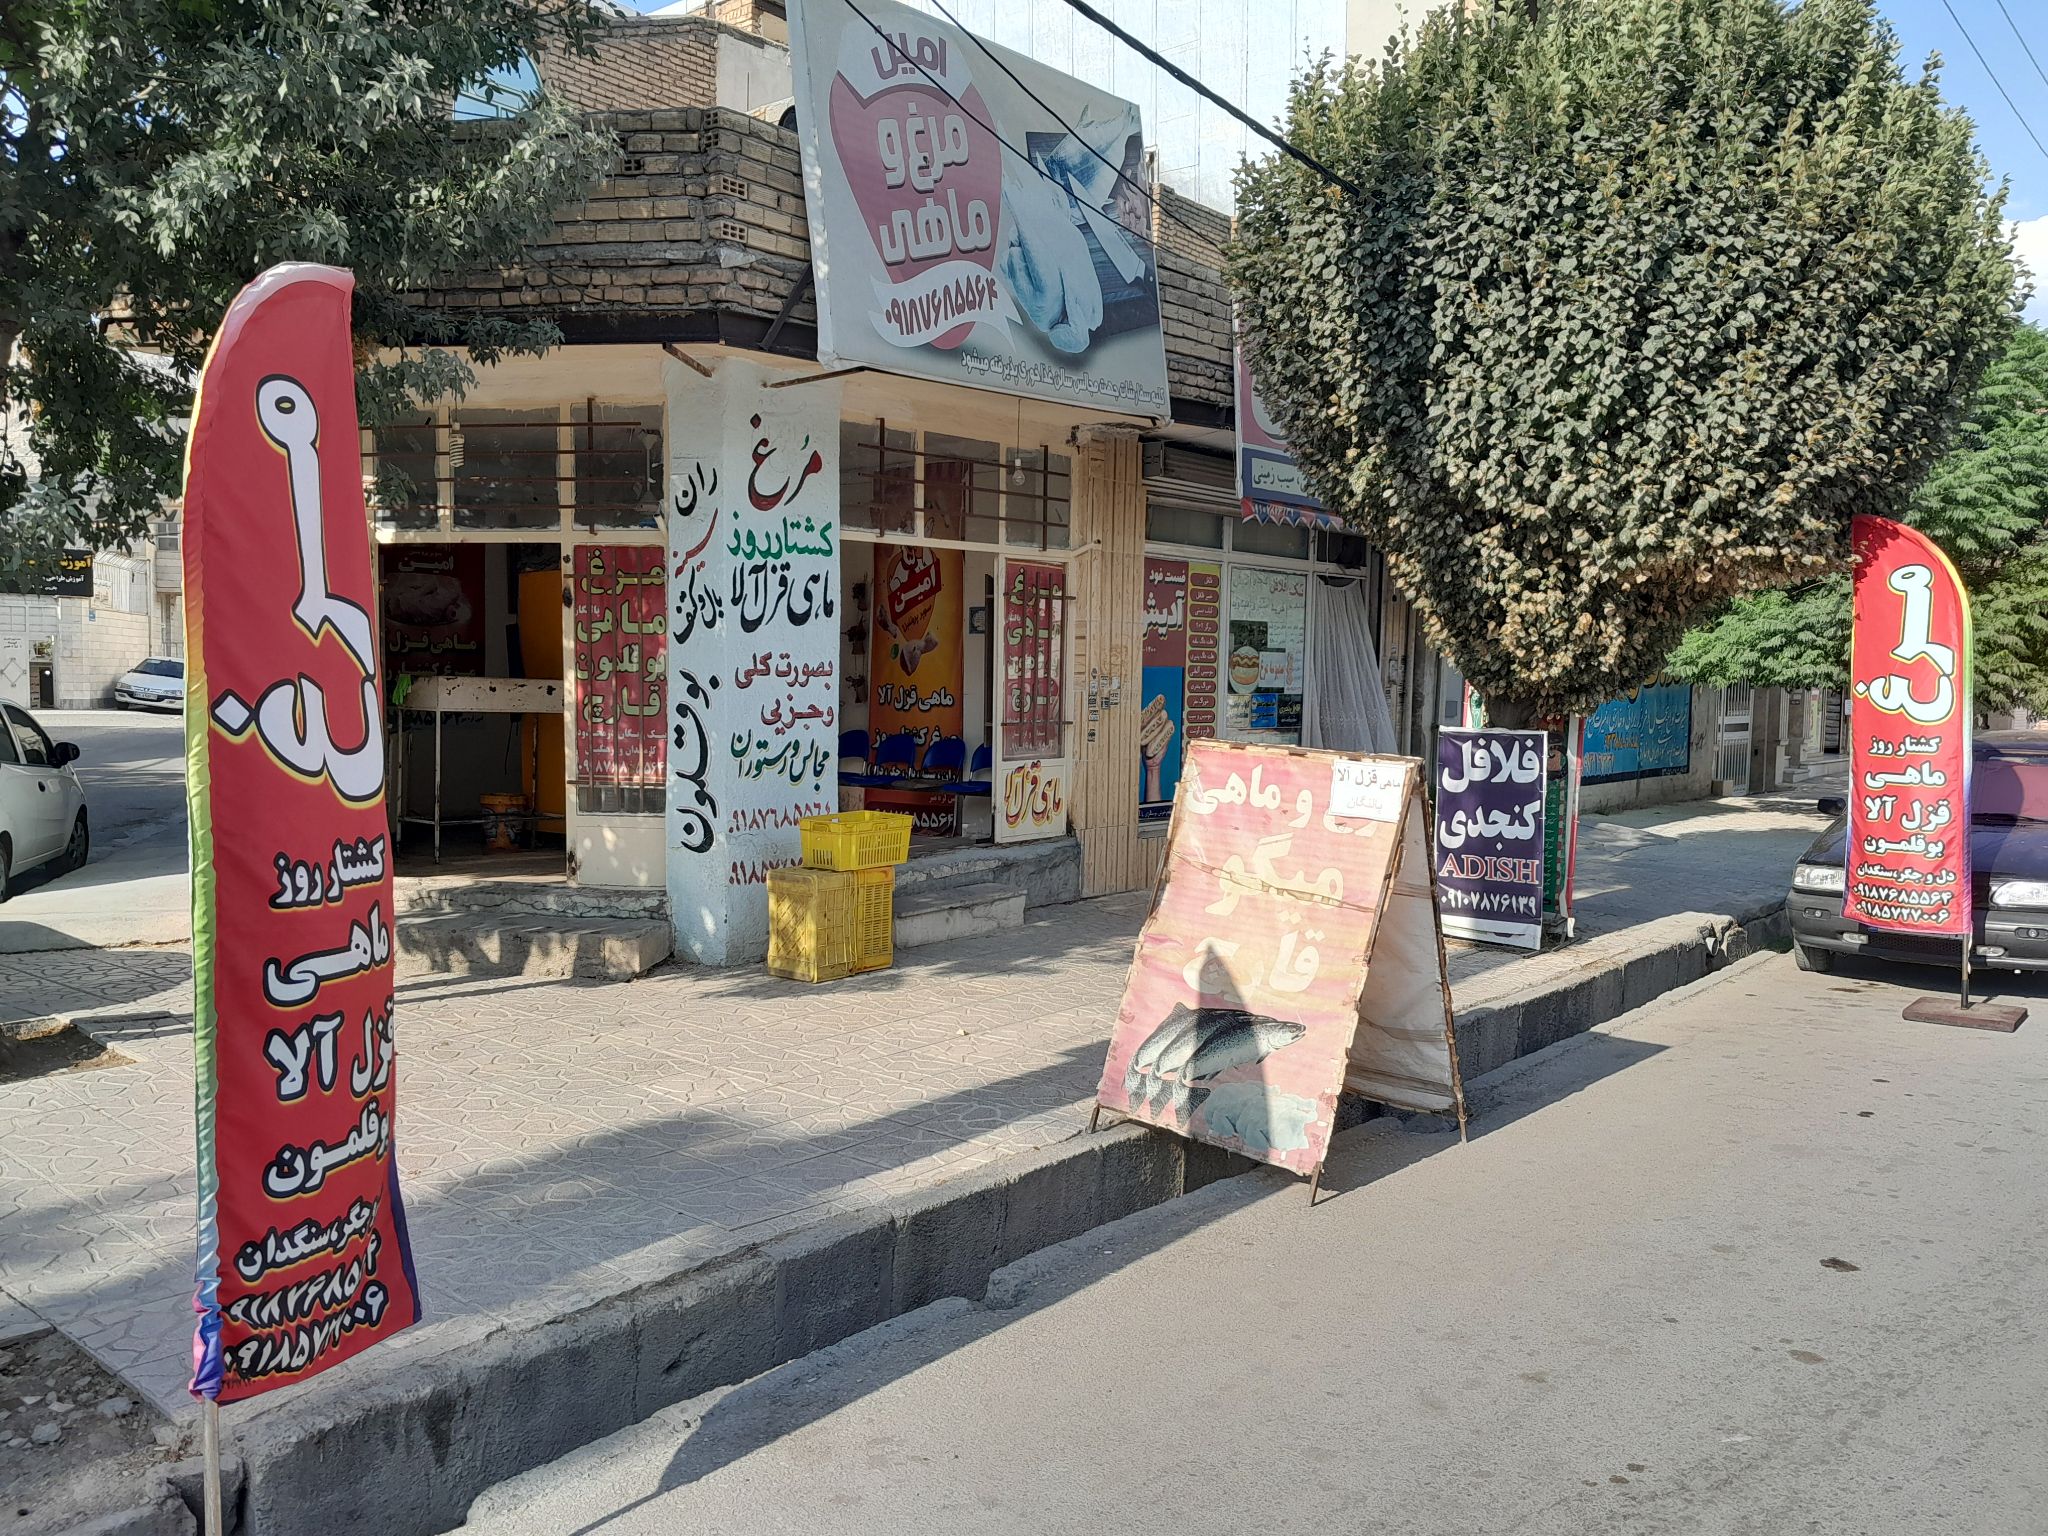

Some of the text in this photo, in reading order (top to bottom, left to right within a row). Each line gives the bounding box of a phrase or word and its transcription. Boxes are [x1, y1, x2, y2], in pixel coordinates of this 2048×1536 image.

[870, 26, 947, 81] امین
[878, 102, 969, 192] مرغ و
[879, 189, 993, 264] ماهی
[885, 275, 998, 337] ۰۹۱۸۷۶۸۵۵۶۴
[674, 461, 718, 517] ران
[894, 563, 937, 613] امین
[1149, 568, 1187, 585] فست فود
[786, 570, 834, 626] ماهی
[430, 633, 477, 654] ماهی
[735, 652, 833, 690] بصورت کلی
[876, 682, 955, 712] ماهی قزل آلا
[1440, 737, 1541, 793] فلافل
[1868, 734, 1941, 756] کشتار روز
[1185, 764, 1282, 815] ماهی
[1355, 769, 1378, 788] قزل
[1863, 760, 1948, 789] ماهی
[1288, 788, 1314, 829] و
[1438, 799, 1541, 851] کنجدی
[1863, 796, 1951, 832] قزل آلا
[1862, 834, 1945, 859] بوقلمون
[271, 834, 386, 908] کشتار روز
[1205, 832, 1344, 925] میگو
[1438, 852, 1541, 886] ADISH
[1925, 872, 1934, 884] و
[1936, 868, 1956, 884] دل
[1440, 888, 1537, 917] ۰۹۱۰۷۸۷۶۱۳۹
[1853, 882, 1954, 905] ۰۹۱۸۷۶۸۵۵۶۴
[263, 902, 391, 1008] ماهی
[264, 1011, 345, 1101] آلا
